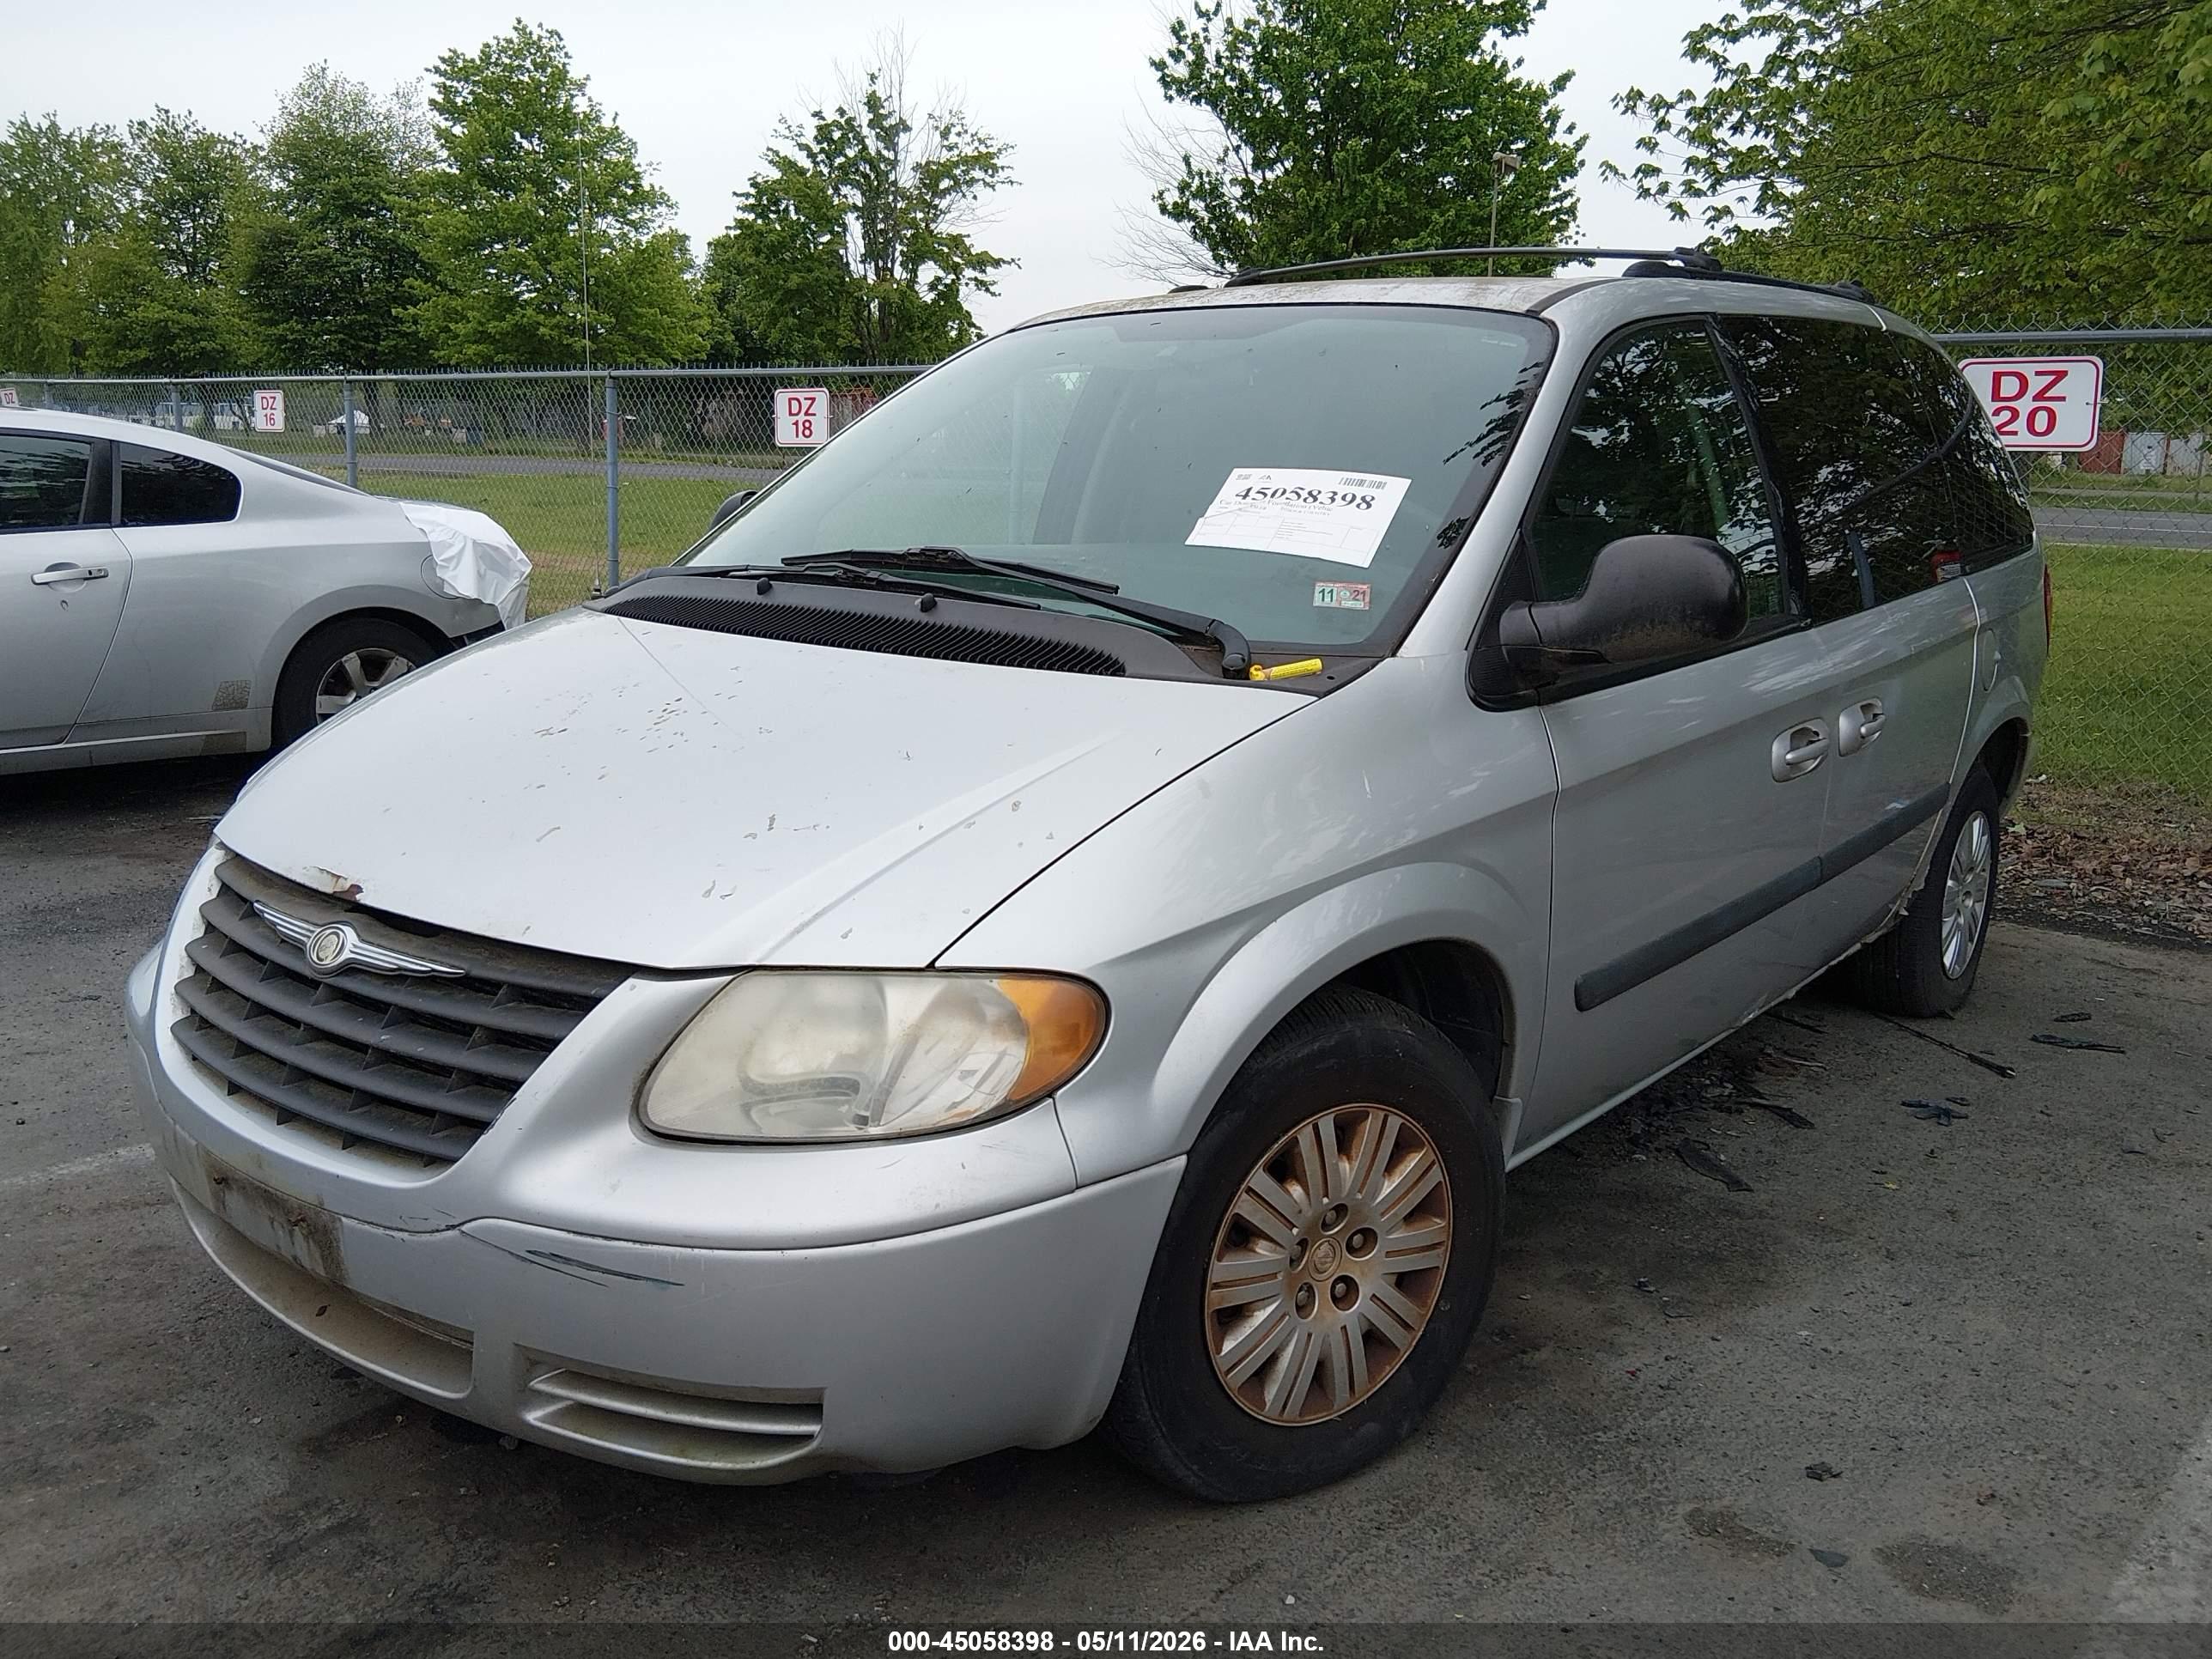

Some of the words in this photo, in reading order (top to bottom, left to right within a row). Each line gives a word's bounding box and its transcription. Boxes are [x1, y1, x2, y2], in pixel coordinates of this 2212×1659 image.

[1990, 369, 2069, 403] DZ
[3, 392, 15, 404] DZ
[261, 396, 276, 410] DZ
[787, 397, 817, 416] DZ
[264, 413, 276, 426] 16
[792, 419, 813, 439] 18
[1990, 405, 2058, 437] 20
[1235, 486, 1376, 511] 45058398
[1318, 587, 1334, 603] 11
[1352, 589, 1367, 603] 21
